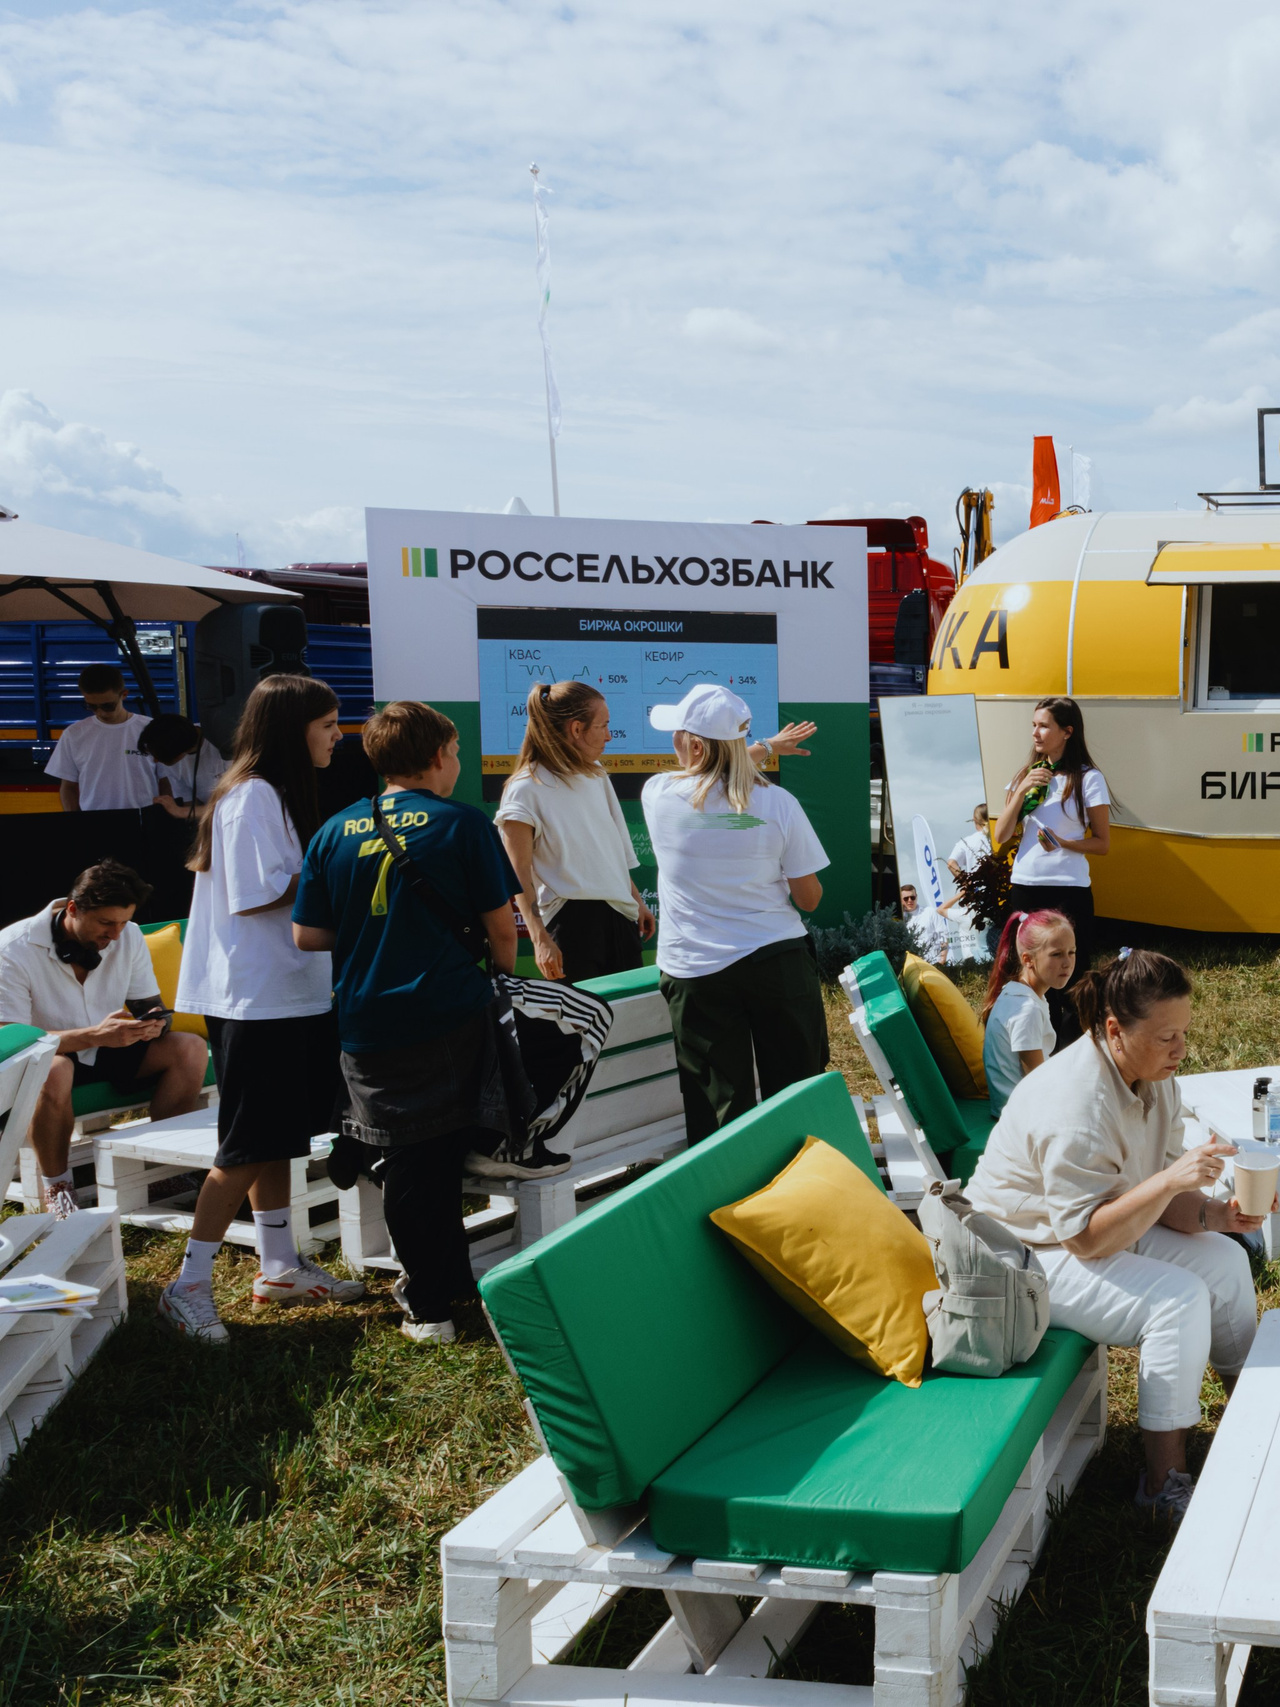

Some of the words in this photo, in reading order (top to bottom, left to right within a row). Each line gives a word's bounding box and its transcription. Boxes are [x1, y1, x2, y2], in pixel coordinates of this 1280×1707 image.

[449, 548, 834, 589] РОССЕЛЬХОЗБАНК
[579, 619, 621, 631] БИРЖА
[624, 620, 683, 633] ОКРОШКИ
[509, 649, 541, 660] КВАС
[645, 651, 684, 662] КЕФИР
[608, 674, 628, 684] 50%
[738, 676, 757, 685] 34%
